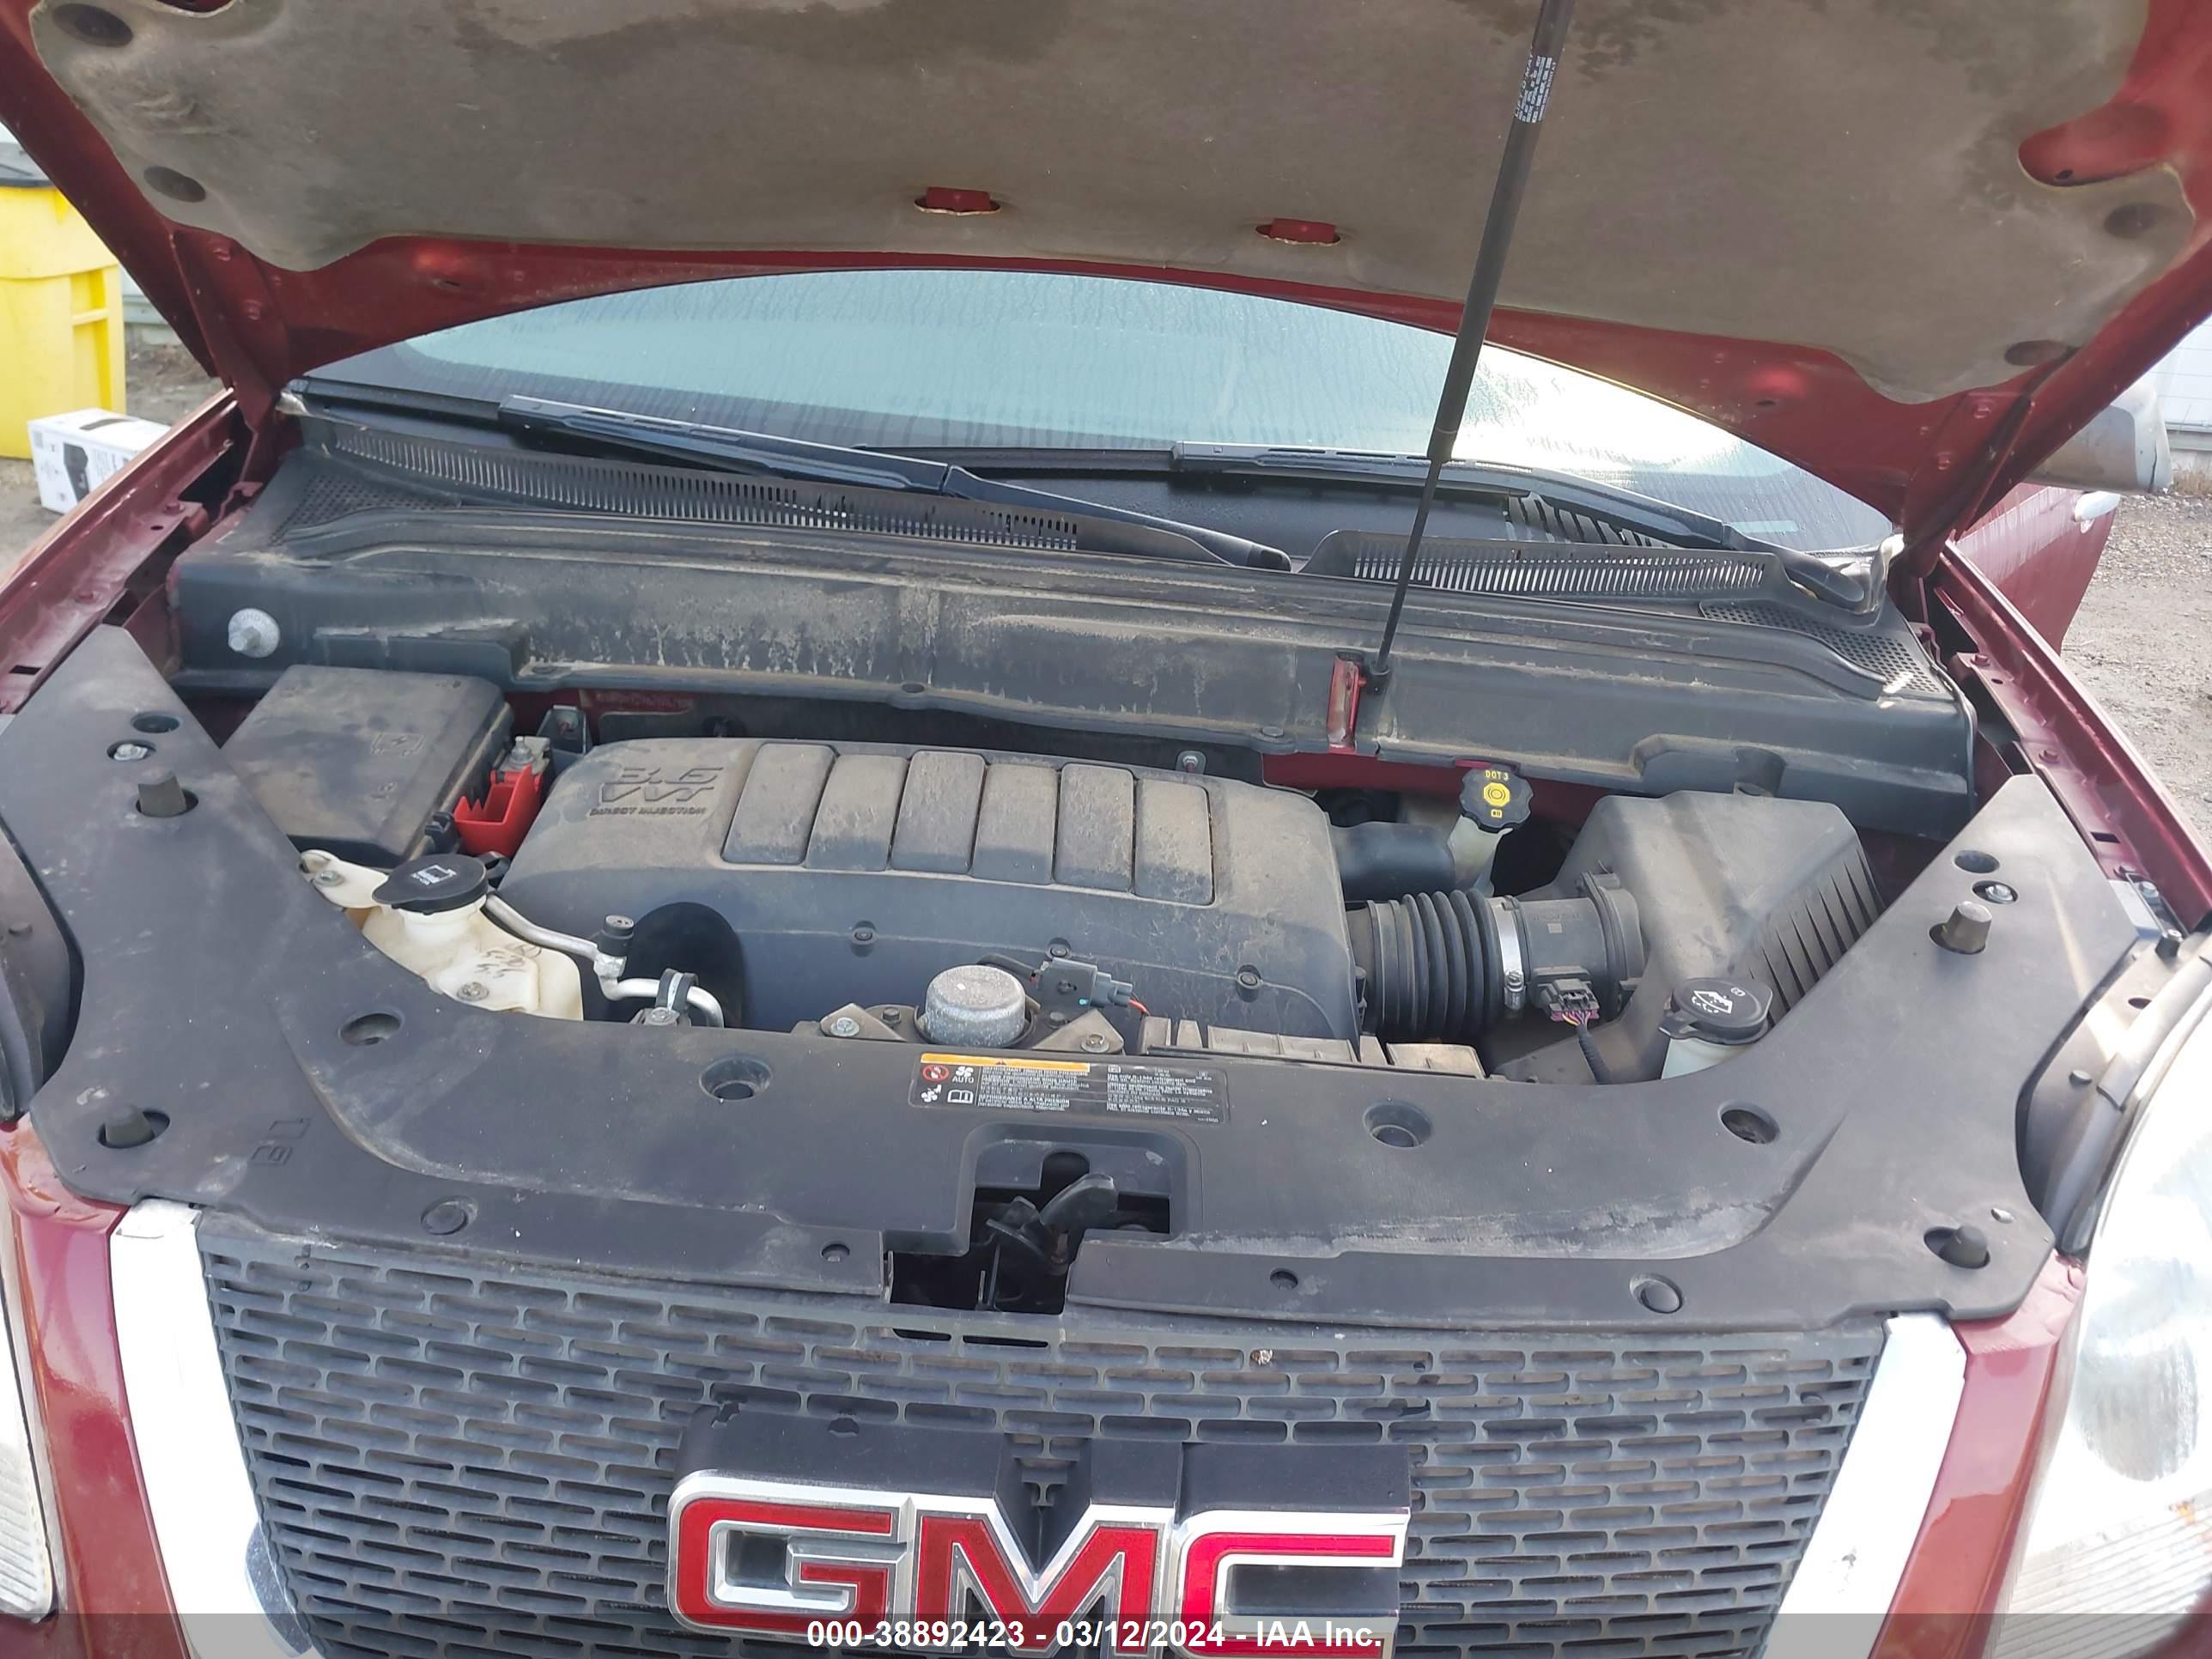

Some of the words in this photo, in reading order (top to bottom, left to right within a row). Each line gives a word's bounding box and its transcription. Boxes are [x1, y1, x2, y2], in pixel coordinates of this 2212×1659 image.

[606, 766, 723, 785] 3.6
[1485, 769, 1502, 779] DOT
[589, 807, 636, 817] DIRECT
[638, 807, 707, 816] INJECTION
[666, 1469, 1410, 1657] GMC
